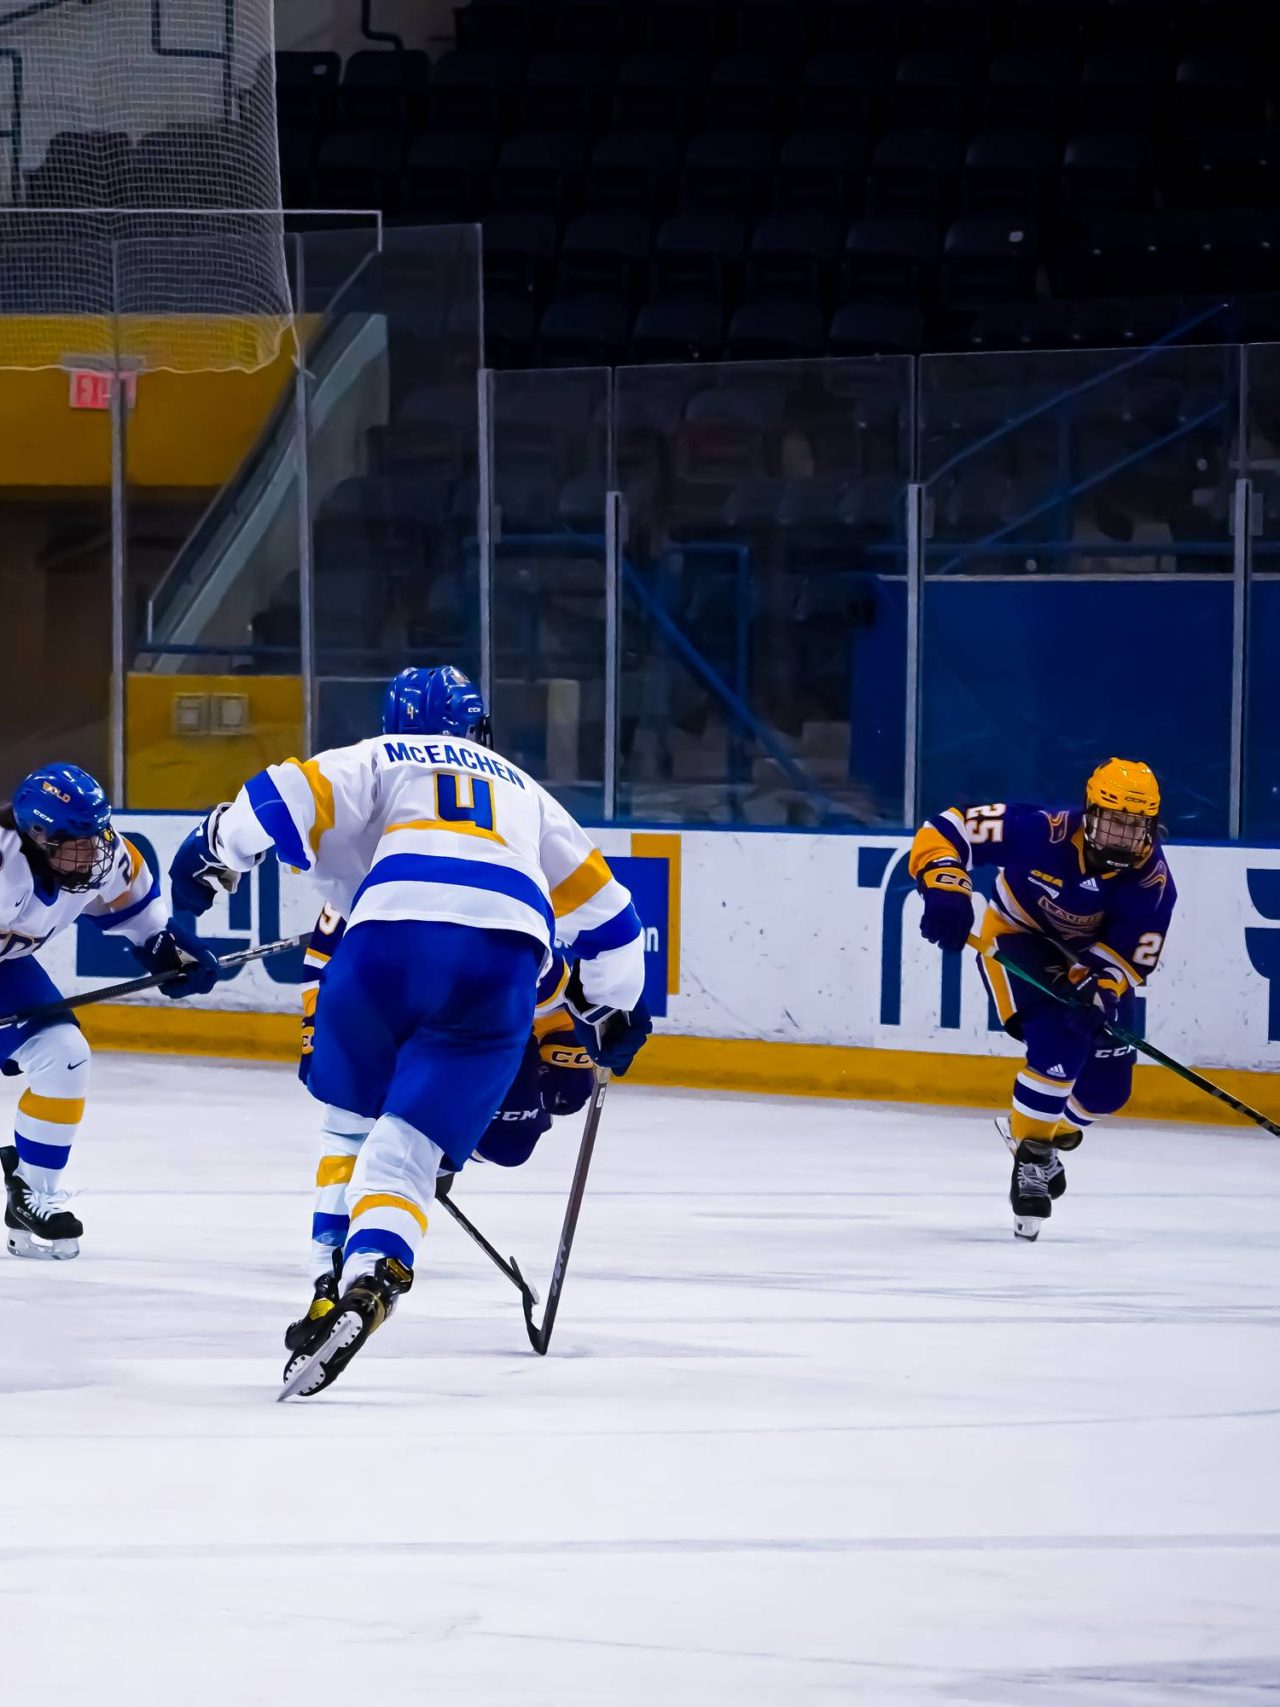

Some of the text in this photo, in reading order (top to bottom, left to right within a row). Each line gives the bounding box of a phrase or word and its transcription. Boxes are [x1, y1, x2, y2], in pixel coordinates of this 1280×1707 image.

[383, 742, 526, 790] McEACHEN
[32, 808, 54, 823] CCM
[433, 771, 498, 832] 4
[965, 803, 1007, 844] 25
[1133, 931, 1164, 967] 2
